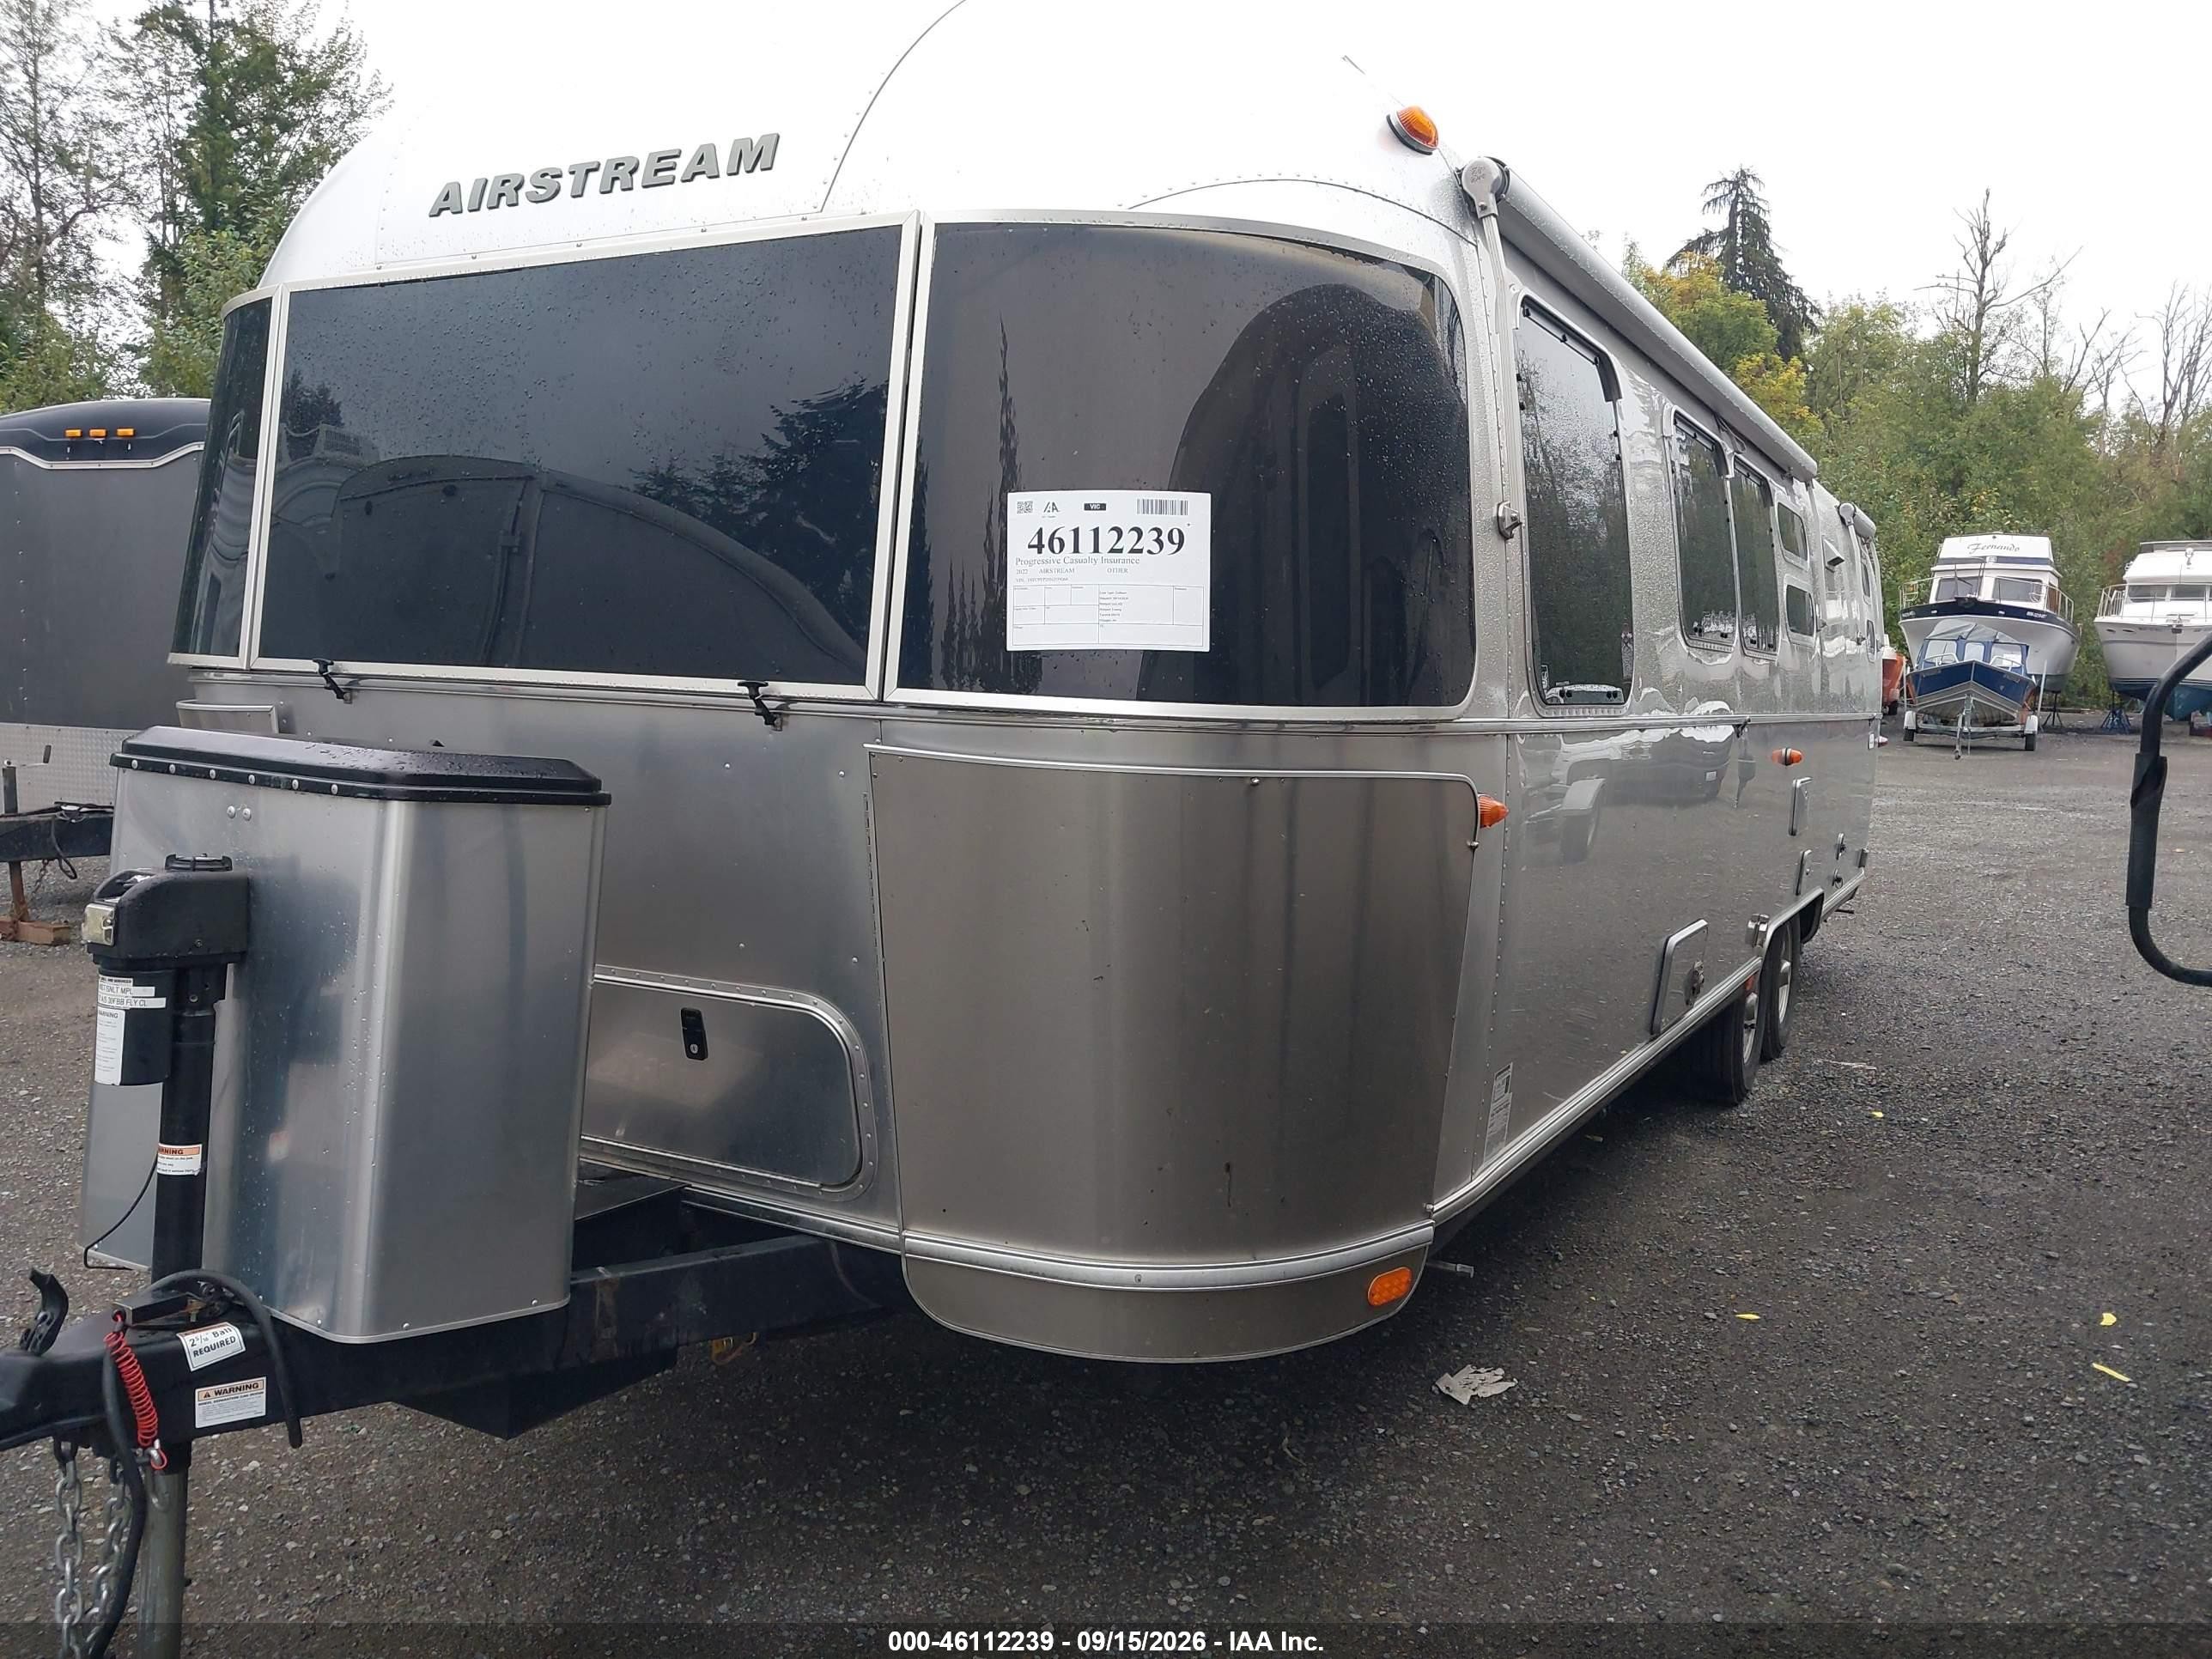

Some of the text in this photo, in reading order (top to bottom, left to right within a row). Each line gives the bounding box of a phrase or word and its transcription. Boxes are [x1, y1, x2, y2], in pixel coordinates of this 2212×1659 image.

[428, 132, 780, 218] AIRSTREAM
[1027, 526, 1185, 556] 46112239
[1016, 556, 1140, 567] Progressive Casualty Insurance
[192, 1335, 236, 1358] REQUIRED
[214, 1382, 259, 1396] WARNING
